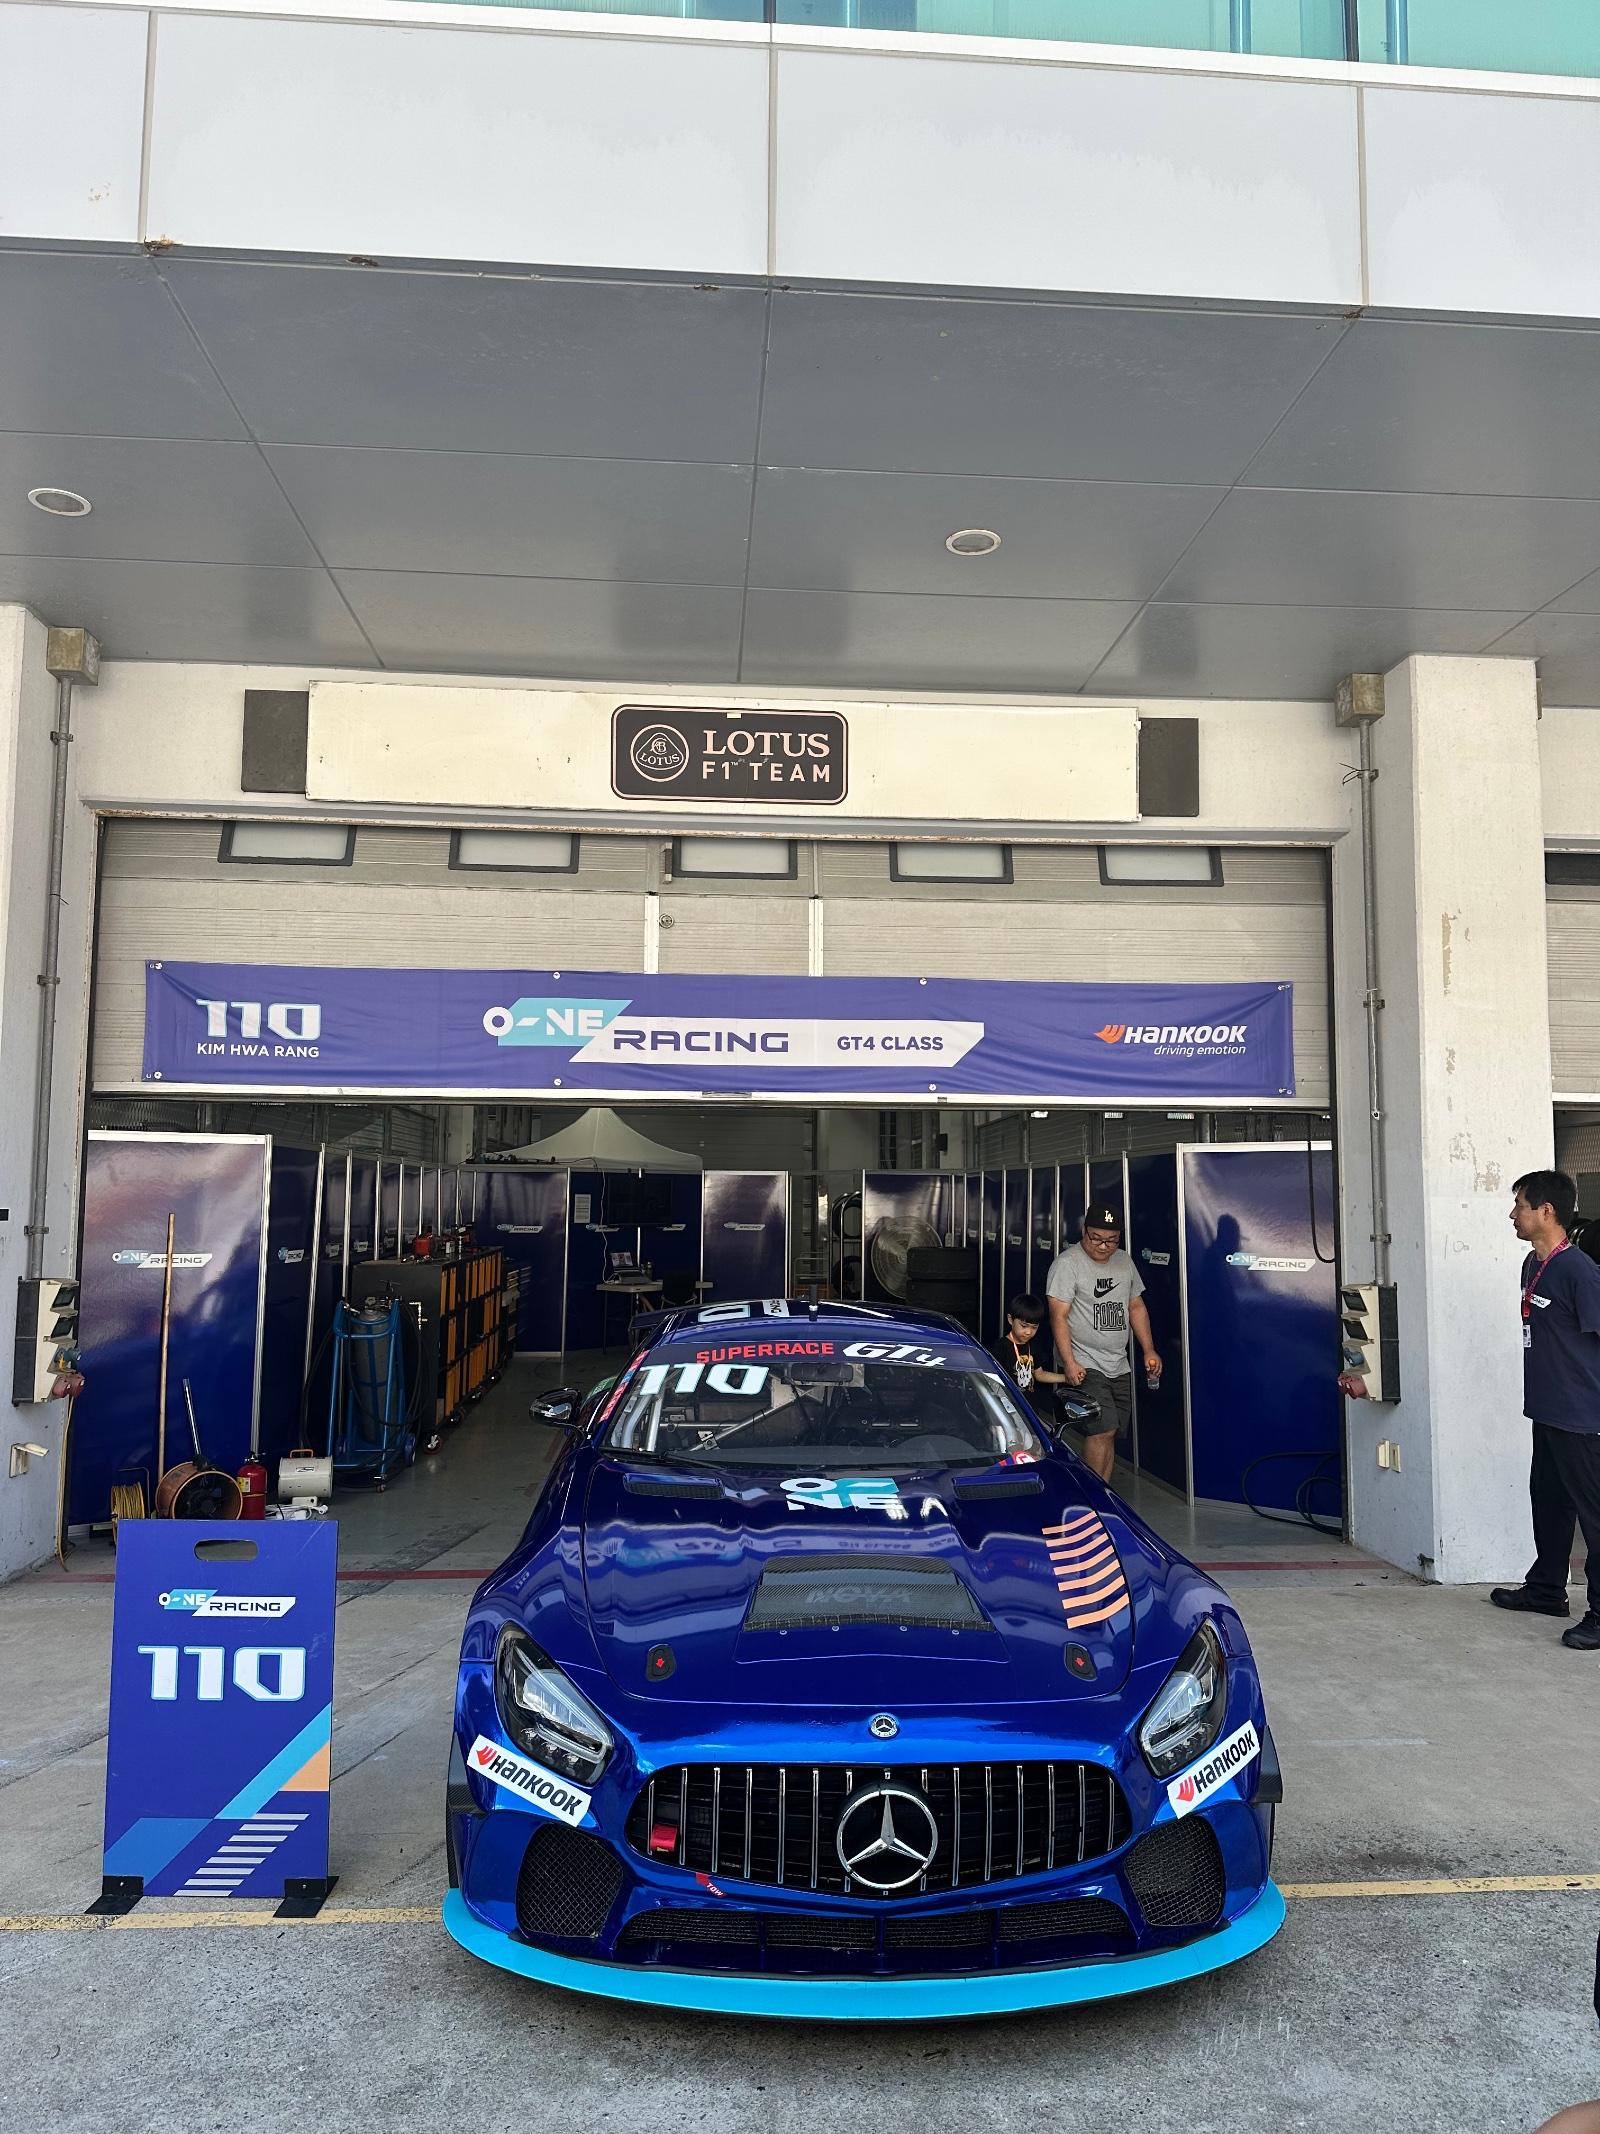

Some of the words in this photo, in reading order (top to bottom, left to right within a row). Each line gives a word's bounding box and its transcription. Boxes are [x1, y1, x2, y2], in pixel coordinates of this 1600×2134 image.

[703, 730, 830, 758] LOTUS
[640, 752, 680, 766] LOTUS
[750, 762, 830, 783] TEAM
[196, 998, 322, 1041] 110
[614, 1029, 789, 1053] RACING
[837, 1036, 876, 1051] GT4
[881, 1036, 944, 1051] CLASS
[197, 1043, 225, 1055] KIM
[230, 1044, 270, 1057] HWA
[274, 1045, 320, 1058] RANG
[1154, 1045, 1195, 1058] driving
[1197, 1045, 1246, 1055] emotion
[1258, 1260, 1307, 1269] RACING
[1097, 1278, 1114, 1289] NIKE
[696, 1343, 834, 1364] SUPERRACE
[639, 1362, 769, 1396] 110
[209, 1602, 281, 1612] RACING
[137, 1645, 306, 1702] 110
[706, 1882, 724, 1896] TOW
